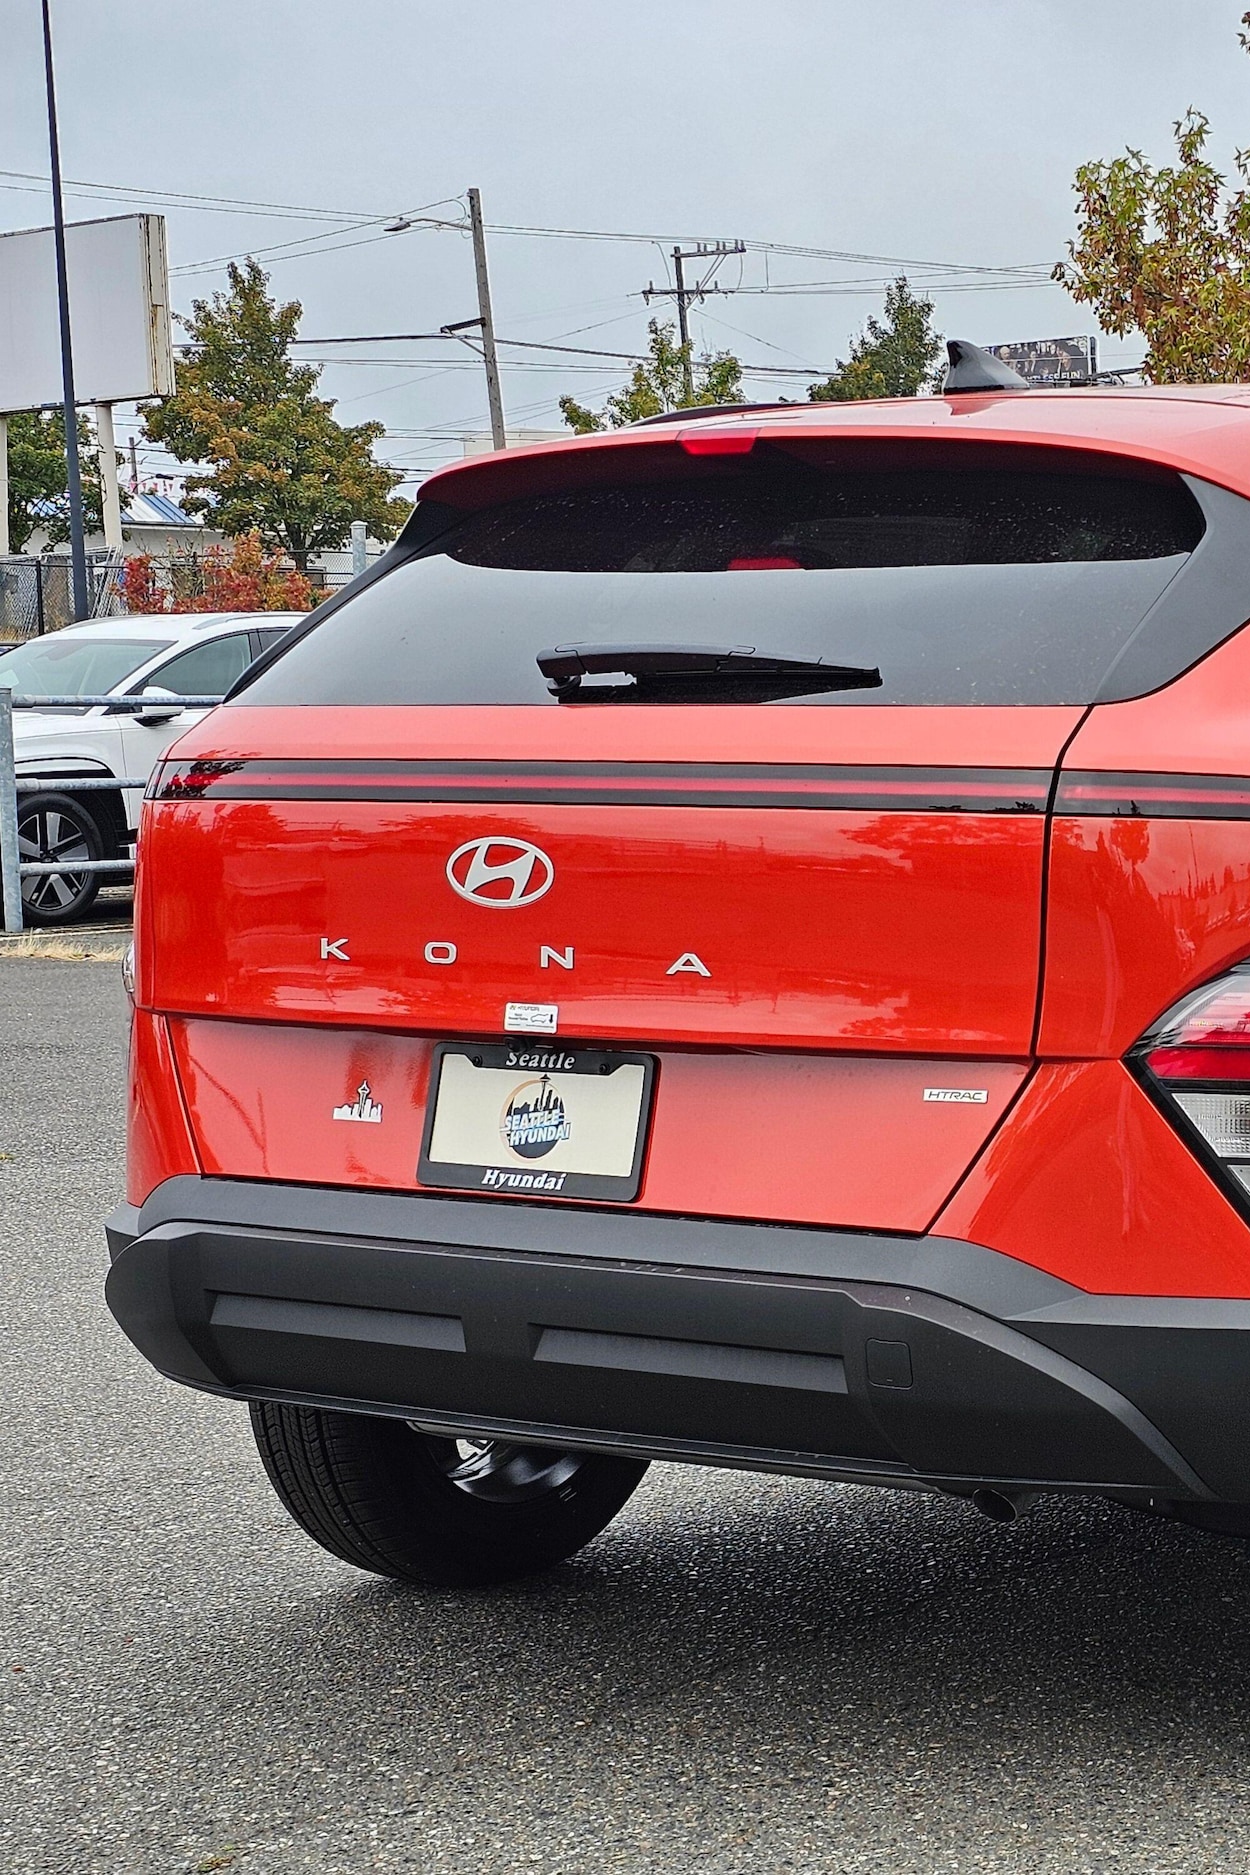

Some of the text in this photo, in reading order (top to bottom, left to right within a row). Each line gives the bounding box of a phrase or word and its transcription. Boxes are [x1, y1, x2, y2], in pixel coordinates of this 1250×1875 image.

[319, 937, 712, 977] KONA
[505, 1052, 575, 1069] Seattle
[928, 1091, 983, 1101] HTRAC
[505, 1108, 561, 1131] SEATTLE
[509, 1122, 571, 1147] HYUNDAI
[482, 1169, 567, 1190] Hyundai
